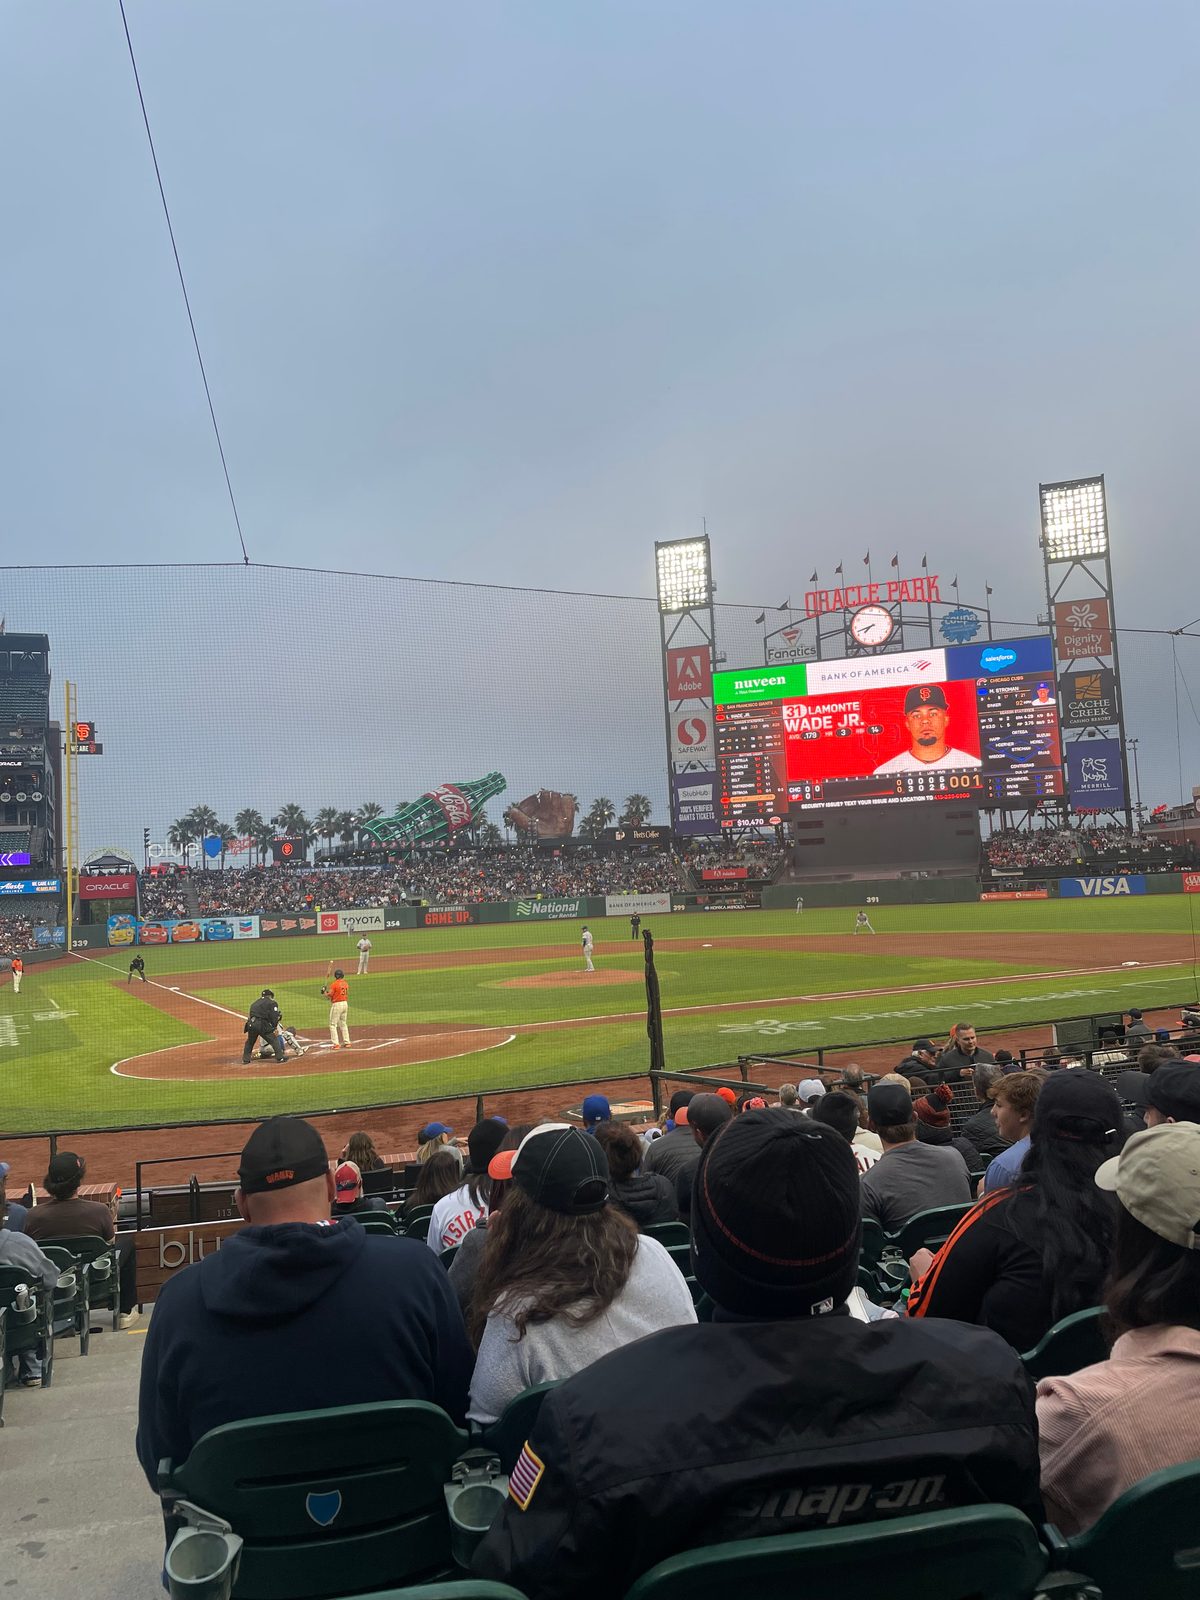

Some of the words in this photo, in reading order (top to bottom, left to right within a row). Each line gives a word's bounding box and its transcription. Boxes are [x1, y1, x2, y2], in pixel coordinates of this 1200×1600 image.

[805, 583, 881, 618] ORACLE
[886, 576, 942, 604] PARK
[944, 614, 977, 625] coupa
[1064, 634, 1103, 647] Dignity
[768, 646, 817, 660] Fanatics
[1066, 645, 1103, 657] Health
[985, 654, 1014, 663] salesforce
[821, 672, 848, 681] BANK
[850, 670, 864, 678] OF
[865, 666, 910, 677] AMERICA
[678, 682, 703, 692] Adobe
[734, 676, 787, 690] nuveen
[786, 706, 802, 717] 31
[808, 701, 861, 715] LAMONTE
[1068, 699, 1111, 711] CACHE
[1070, 708, 1110, 718] CREEK
[785, 716, 834, 733] WADE
[838, 713, 866, 729] JR.
[803, 732, 818, 740] .179
[682, 790, 709, 798] StubHub
[872, 798, 888, 806] ISSUE
[900, 795, 924, 803] LOCATION
[692, 804, 713, 813] VERIFIED
[678, 814, 696, 822] GIANTS
[695, 812, 715, 821] TICKETS
[737, 818, 765, 827] $10,470
[149, 838, 200, 859] blue
[86, 883, 130, 895] ORACLE
[1076, 877, 1131, 896] VISA
[866, 896, 880, 904] 391
[531, 901, 580, 914] National
[673, 903, 686, 912] 399
[425, 912, 454, 925] GAME
[456, 911, 470, 922] UP
[560, 911, 578, 919] Rental
[342, 916, 382, 926] TOYOTA
[386, 919, 402, 928] 354
[38, 930, 63, 938] Alska
[72, 939, 89, 949] 339
[830, 1001, 990, 1023] Dignity
[990, 989, 1120, 1006] Health
[217, 1209, 233, 1218] 113
[160, 1231, 222, 1268] blu
